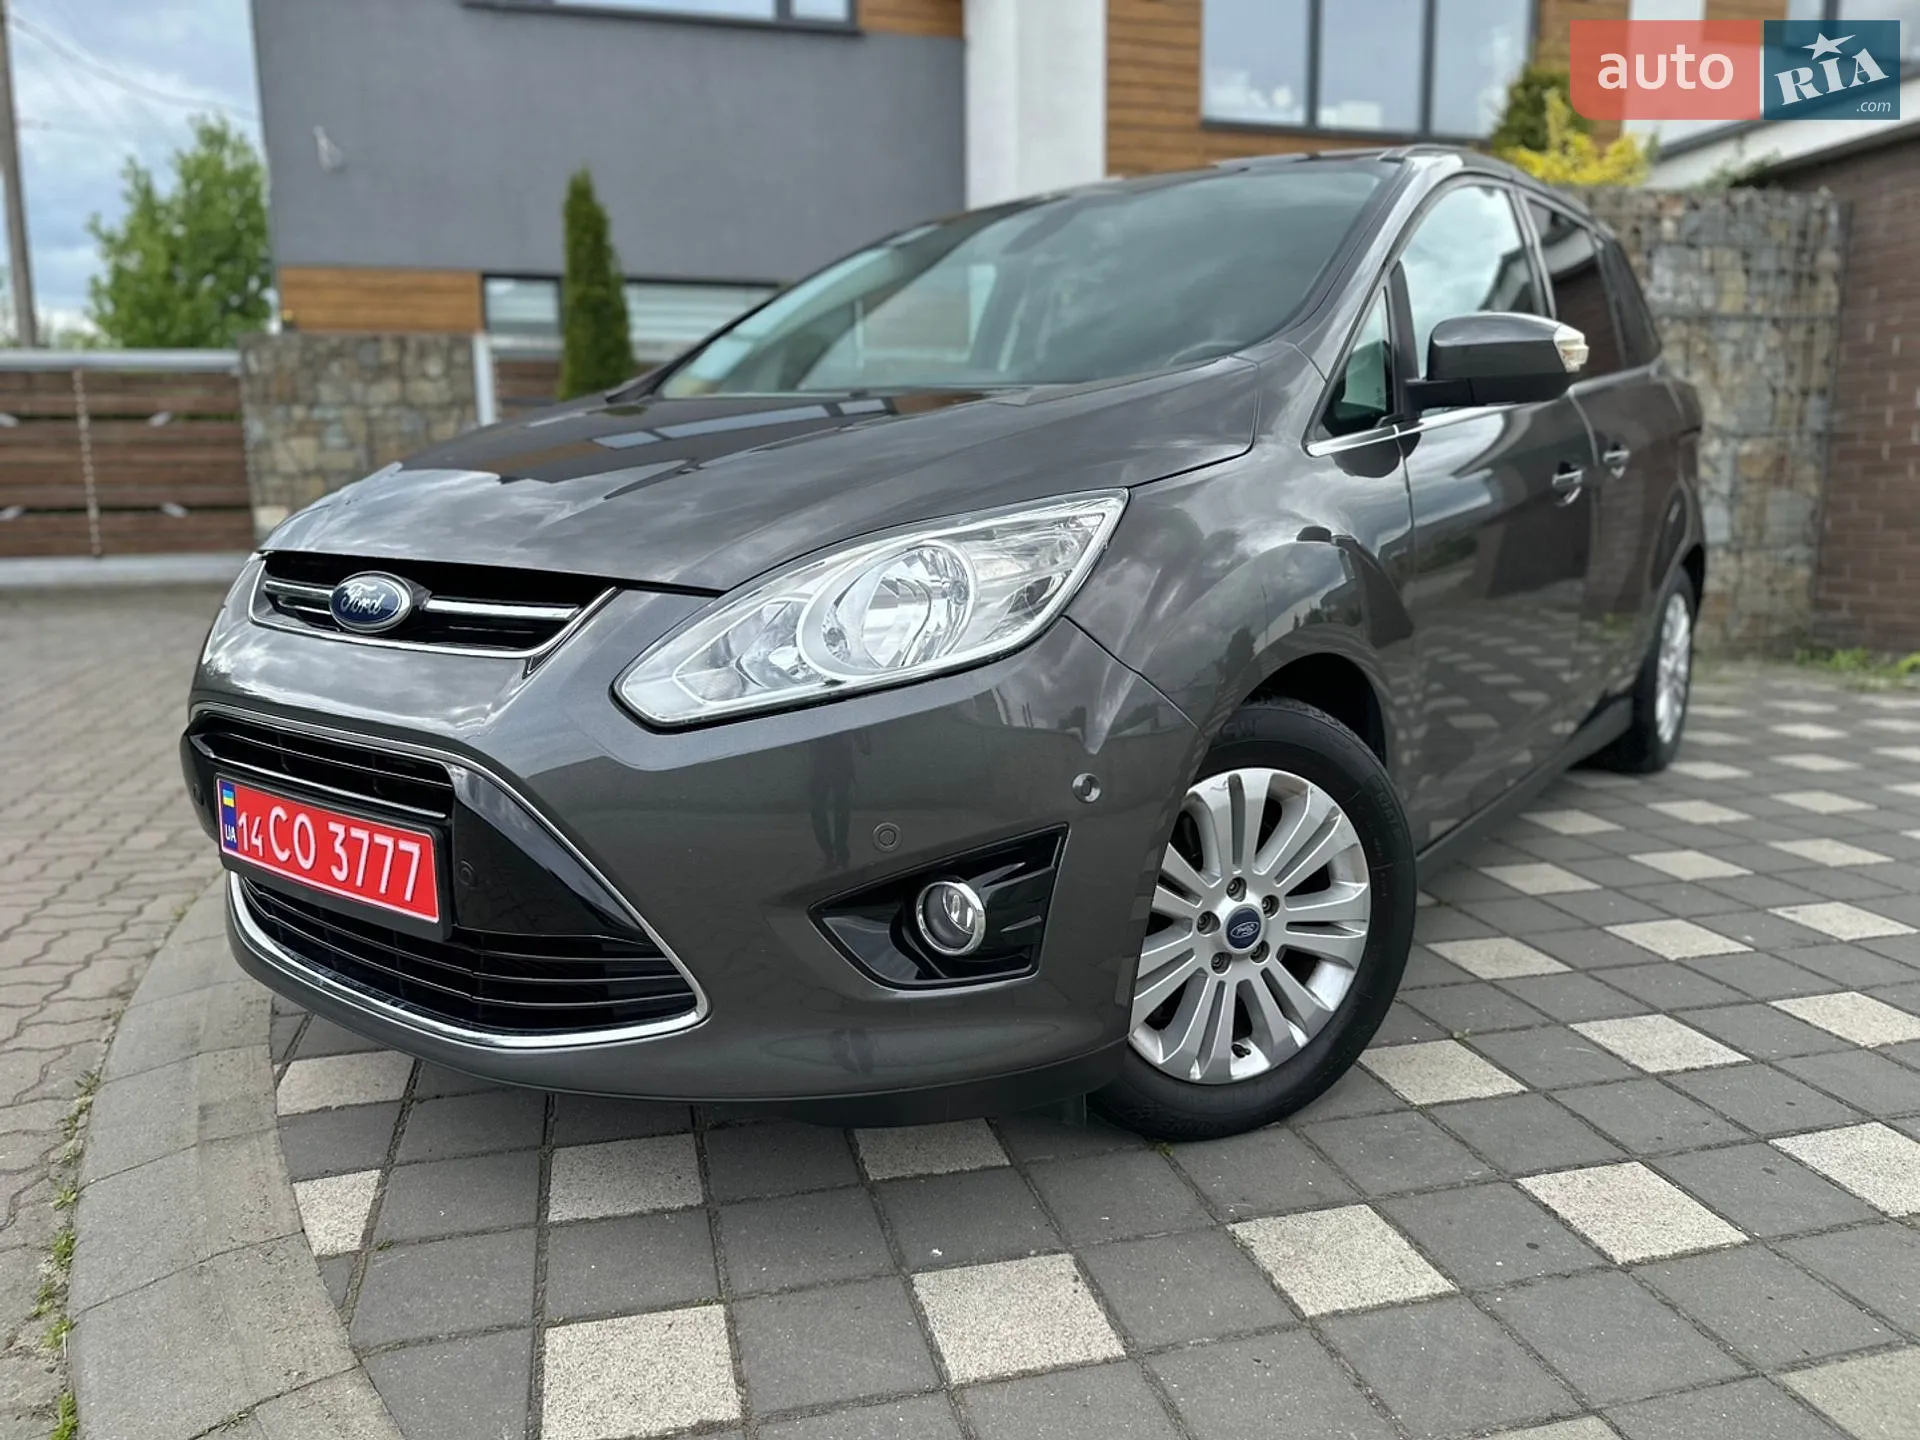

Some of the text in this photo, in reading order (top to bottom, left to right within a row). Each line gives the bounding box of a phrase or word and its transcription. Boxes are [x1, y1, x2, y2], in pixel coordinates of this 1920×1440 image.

[341, 582, 386, 615] Ford
[225, 823, 237, 843] UA
[328, 821, 421, 902] 3777
